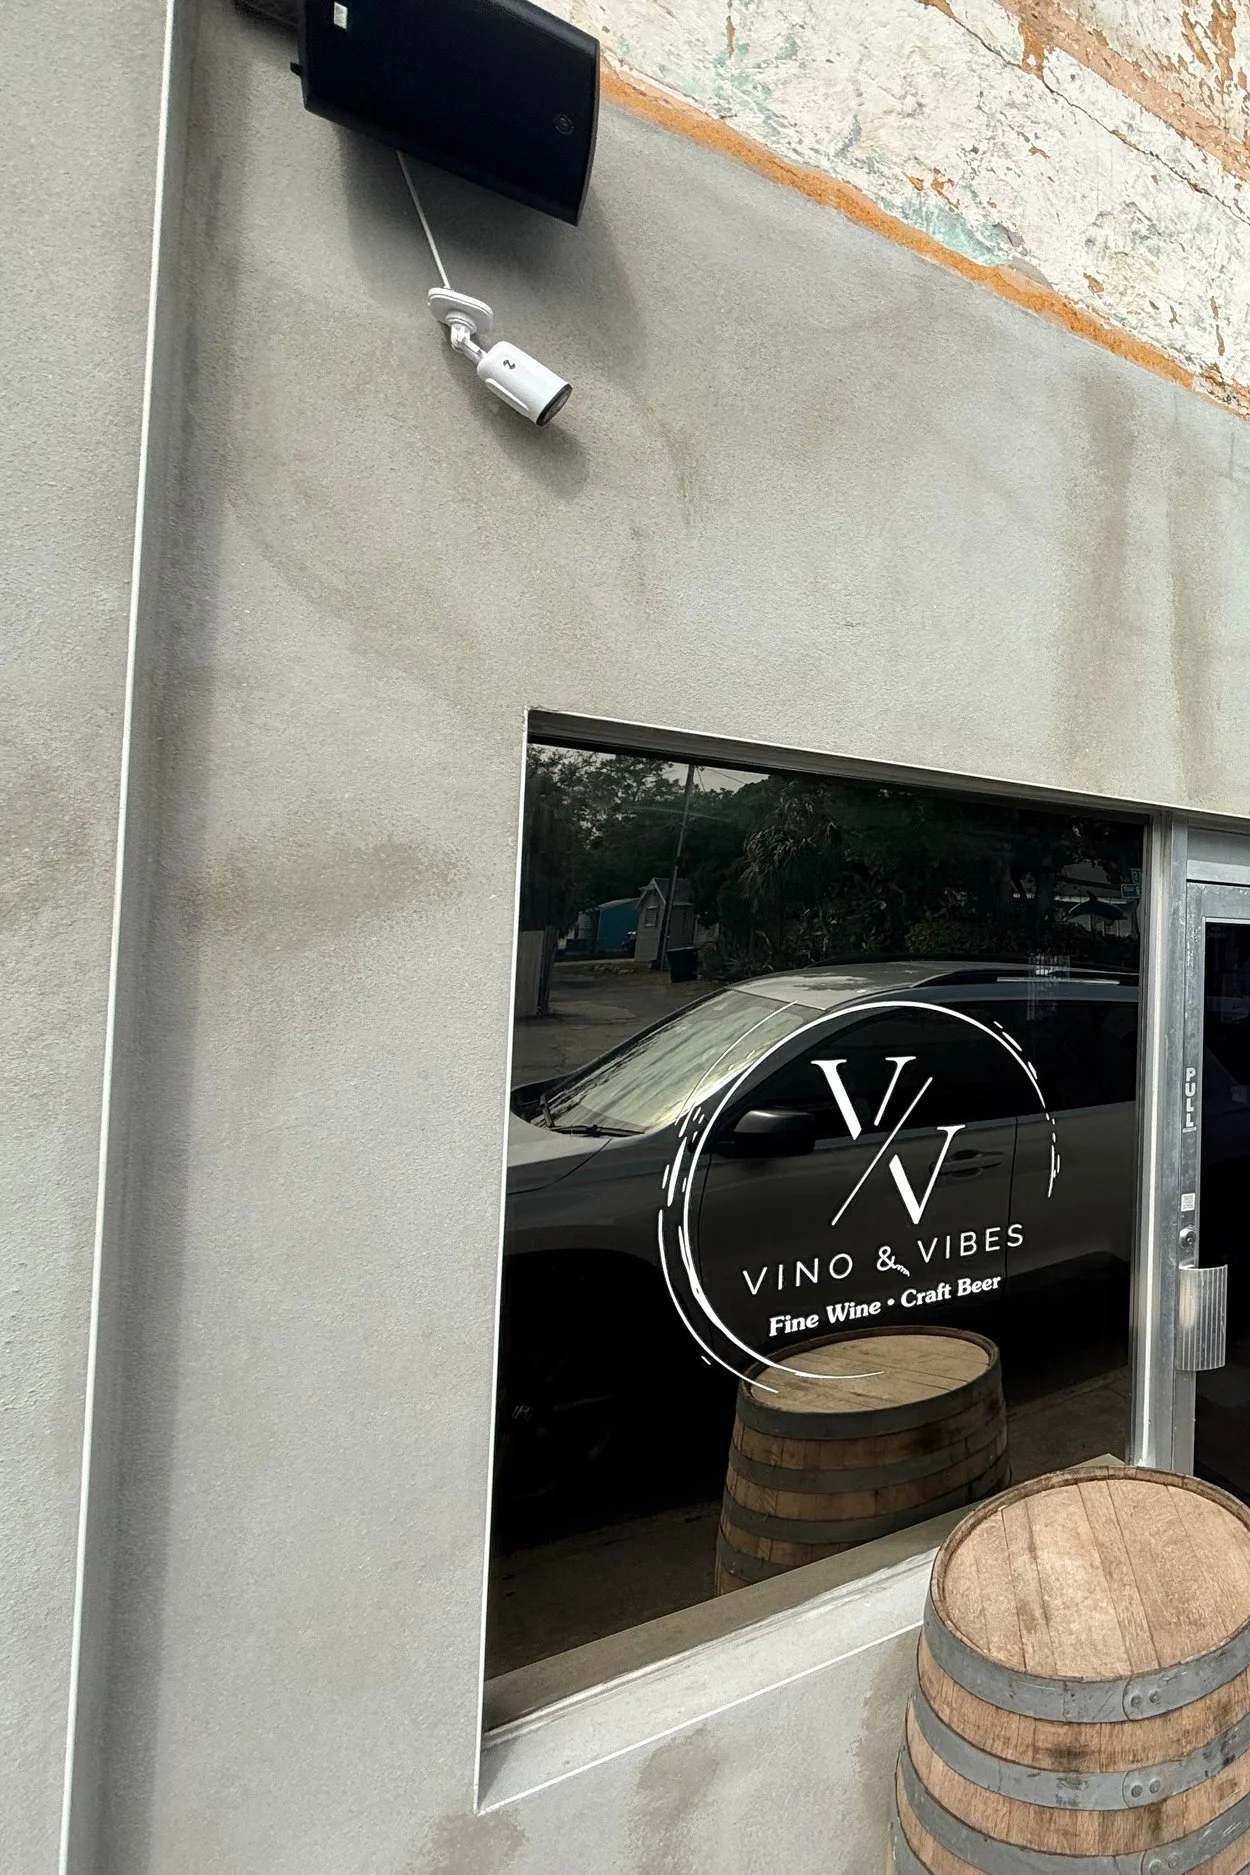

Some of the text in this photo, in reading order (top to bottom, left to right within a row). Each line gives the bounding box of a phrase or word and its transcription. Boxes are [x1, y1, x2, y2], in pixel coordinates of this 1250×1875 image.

[1185, 1067, 1196, 1127] PULL
[742, 1223, 1024, 1295] VINO & VIBES
[769, 1313, 819, 1337] Fine
[826, 1300, 881, 1324] Wine
[900, 1282, 951, 1308] Craft
[957, 1276, 1001, 1297] Beer
